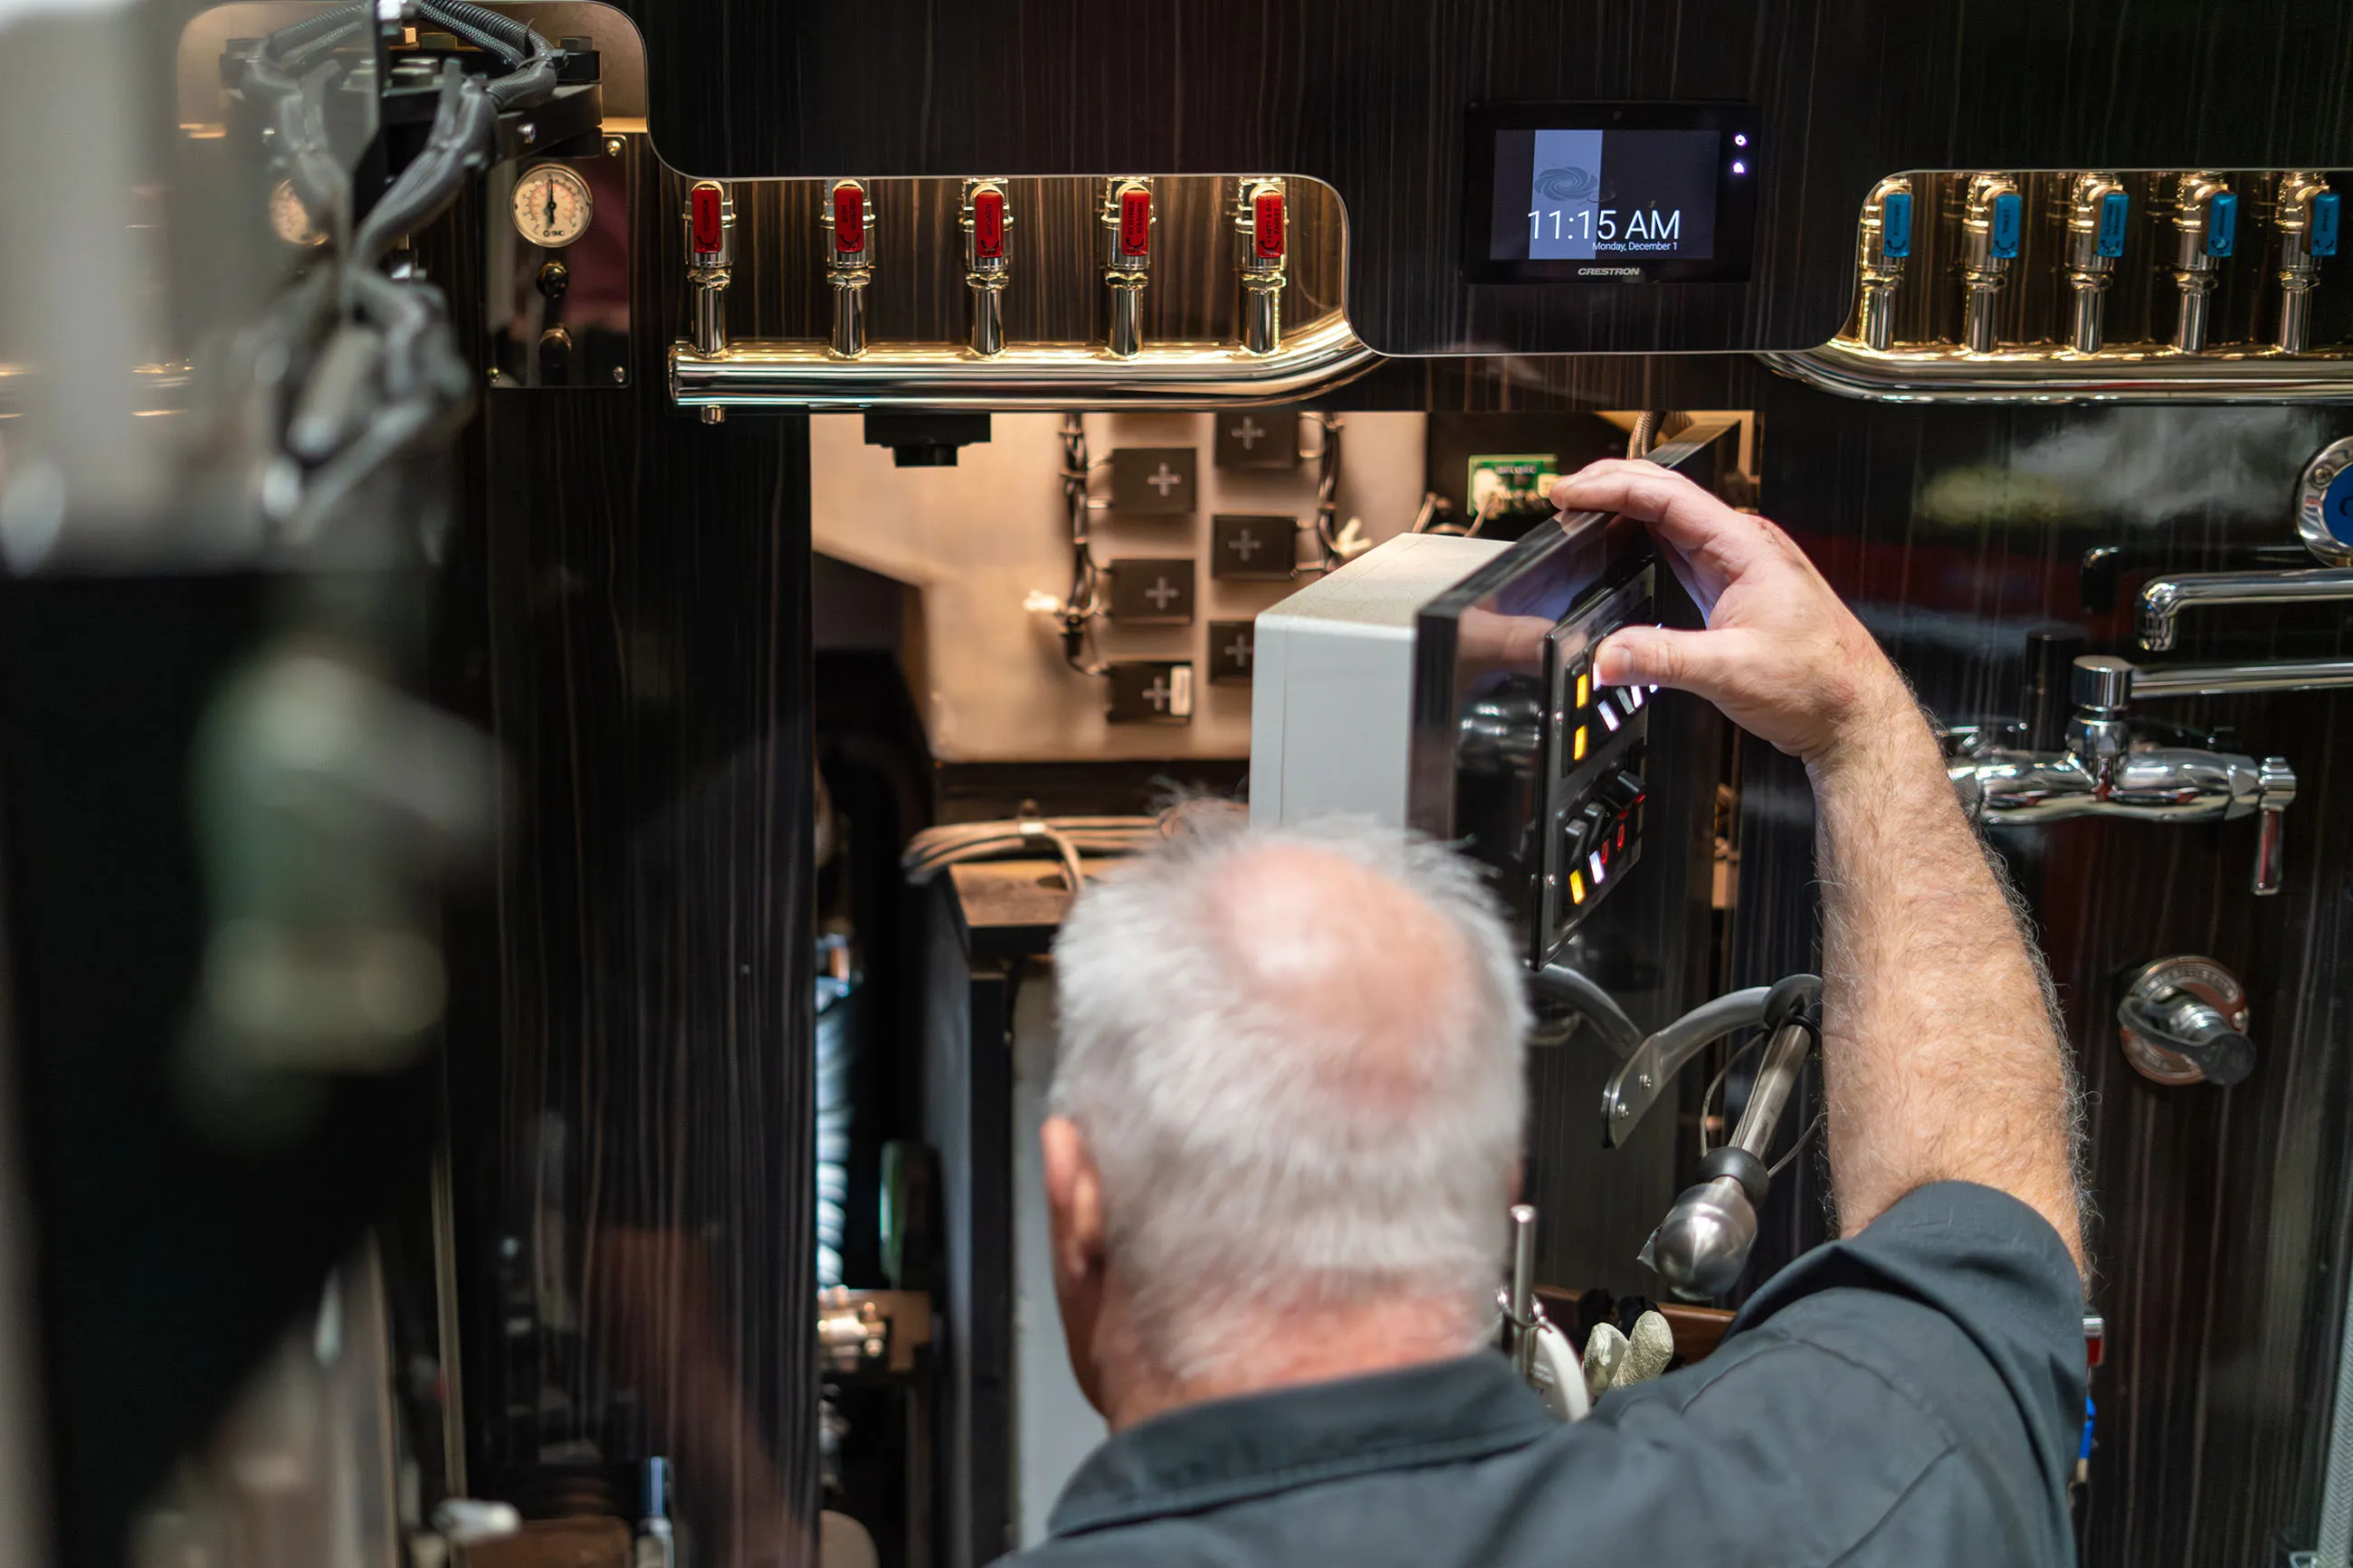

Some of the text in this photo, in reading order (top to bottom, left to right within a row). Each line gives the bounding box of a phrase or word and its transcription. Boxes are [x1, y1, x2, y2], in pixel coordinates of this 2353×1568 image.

[1528, 210, 1681, 240] 11:15 AM
[1592, 242, 1677, 252] Monday, December 1
[1577, 267, 1640, 276] CRESTRON
